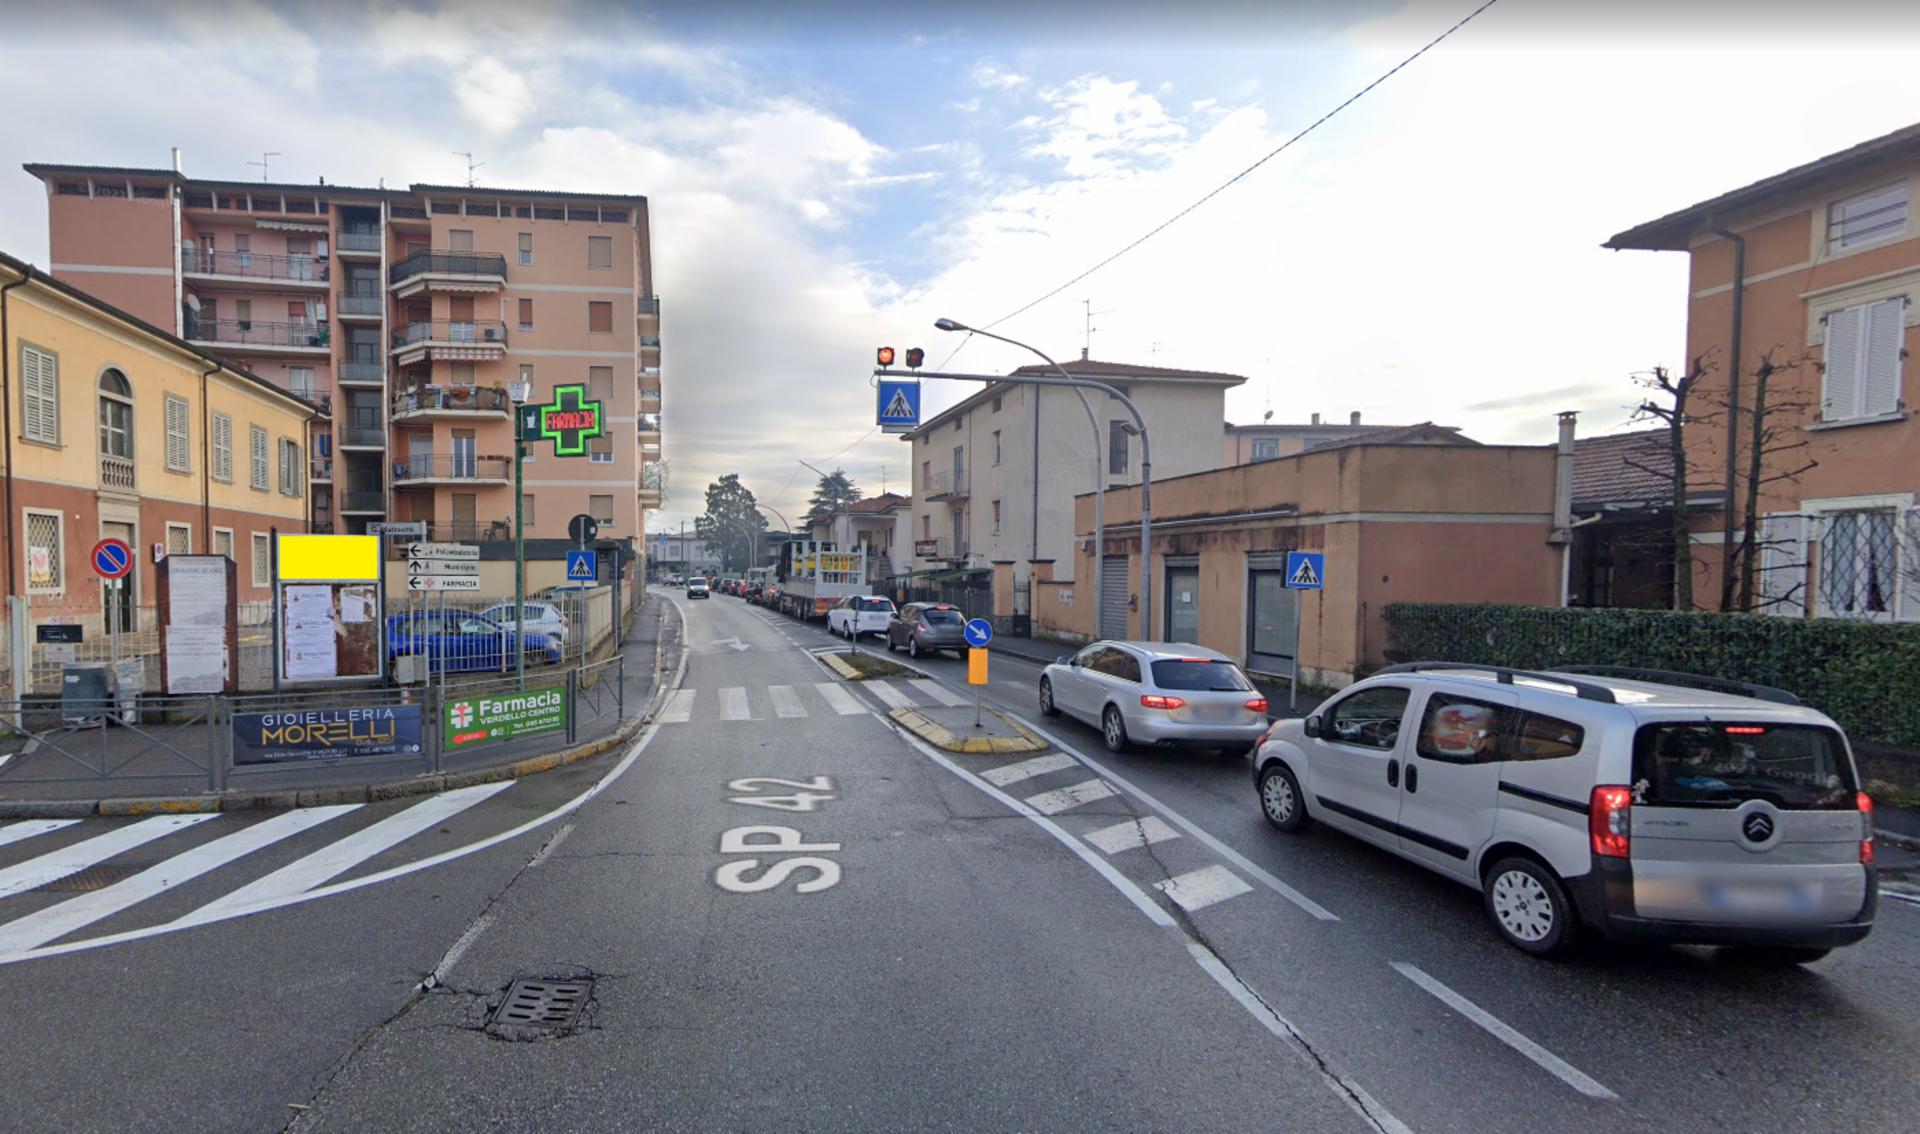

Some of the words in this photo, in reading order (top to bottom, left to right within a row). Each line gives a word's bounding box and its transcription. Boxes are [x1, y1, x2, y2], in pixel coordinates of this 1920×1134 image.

[546, 411, 595, 430] FARMACIA
[442, 580, 477, 588] FARMACIA
[479, 690, 561, 716] Farmacia
[262, 708, 395, 726] GIOIELLERIA
[480, 711, 526, 725] VERDELLO
[528, 706, 560, 717] CENTRO
[262, 719, 395, 746] MORELLI
[727, 775, 838, 812] 42
[716, 825, 841, 893] SP
